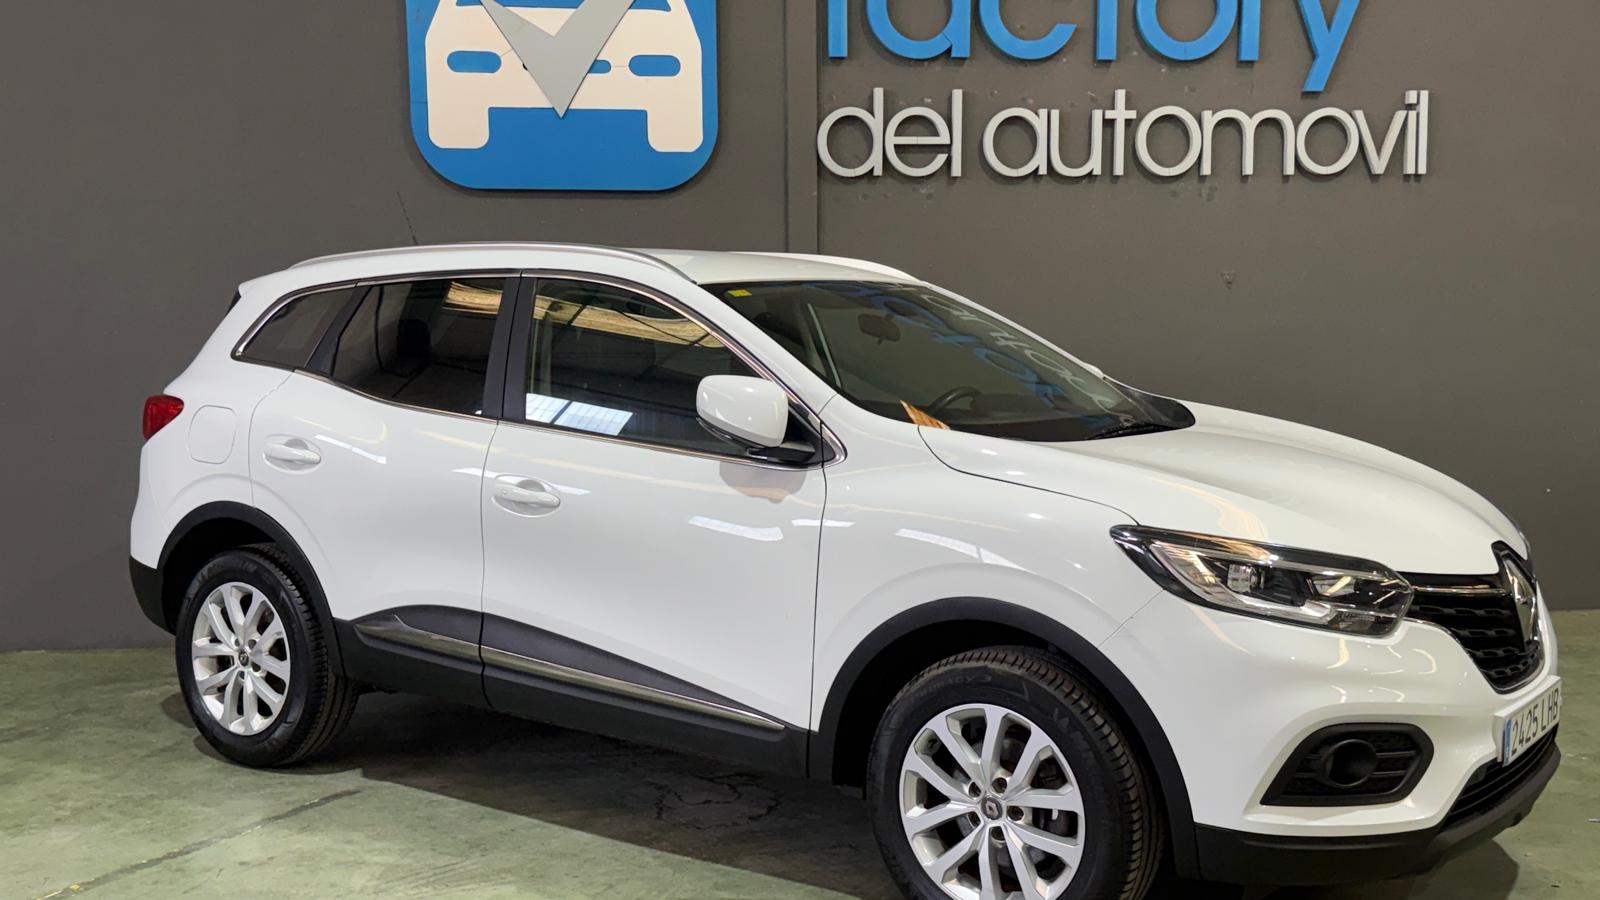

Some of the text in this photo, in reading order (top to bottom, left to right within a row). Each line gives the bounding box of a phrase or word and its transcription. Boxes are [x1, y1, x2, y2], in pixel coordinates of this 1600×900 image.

[817, 87, 1429, 177] del automovil
[1512, 688, 1559, 755] 2425 LHB
